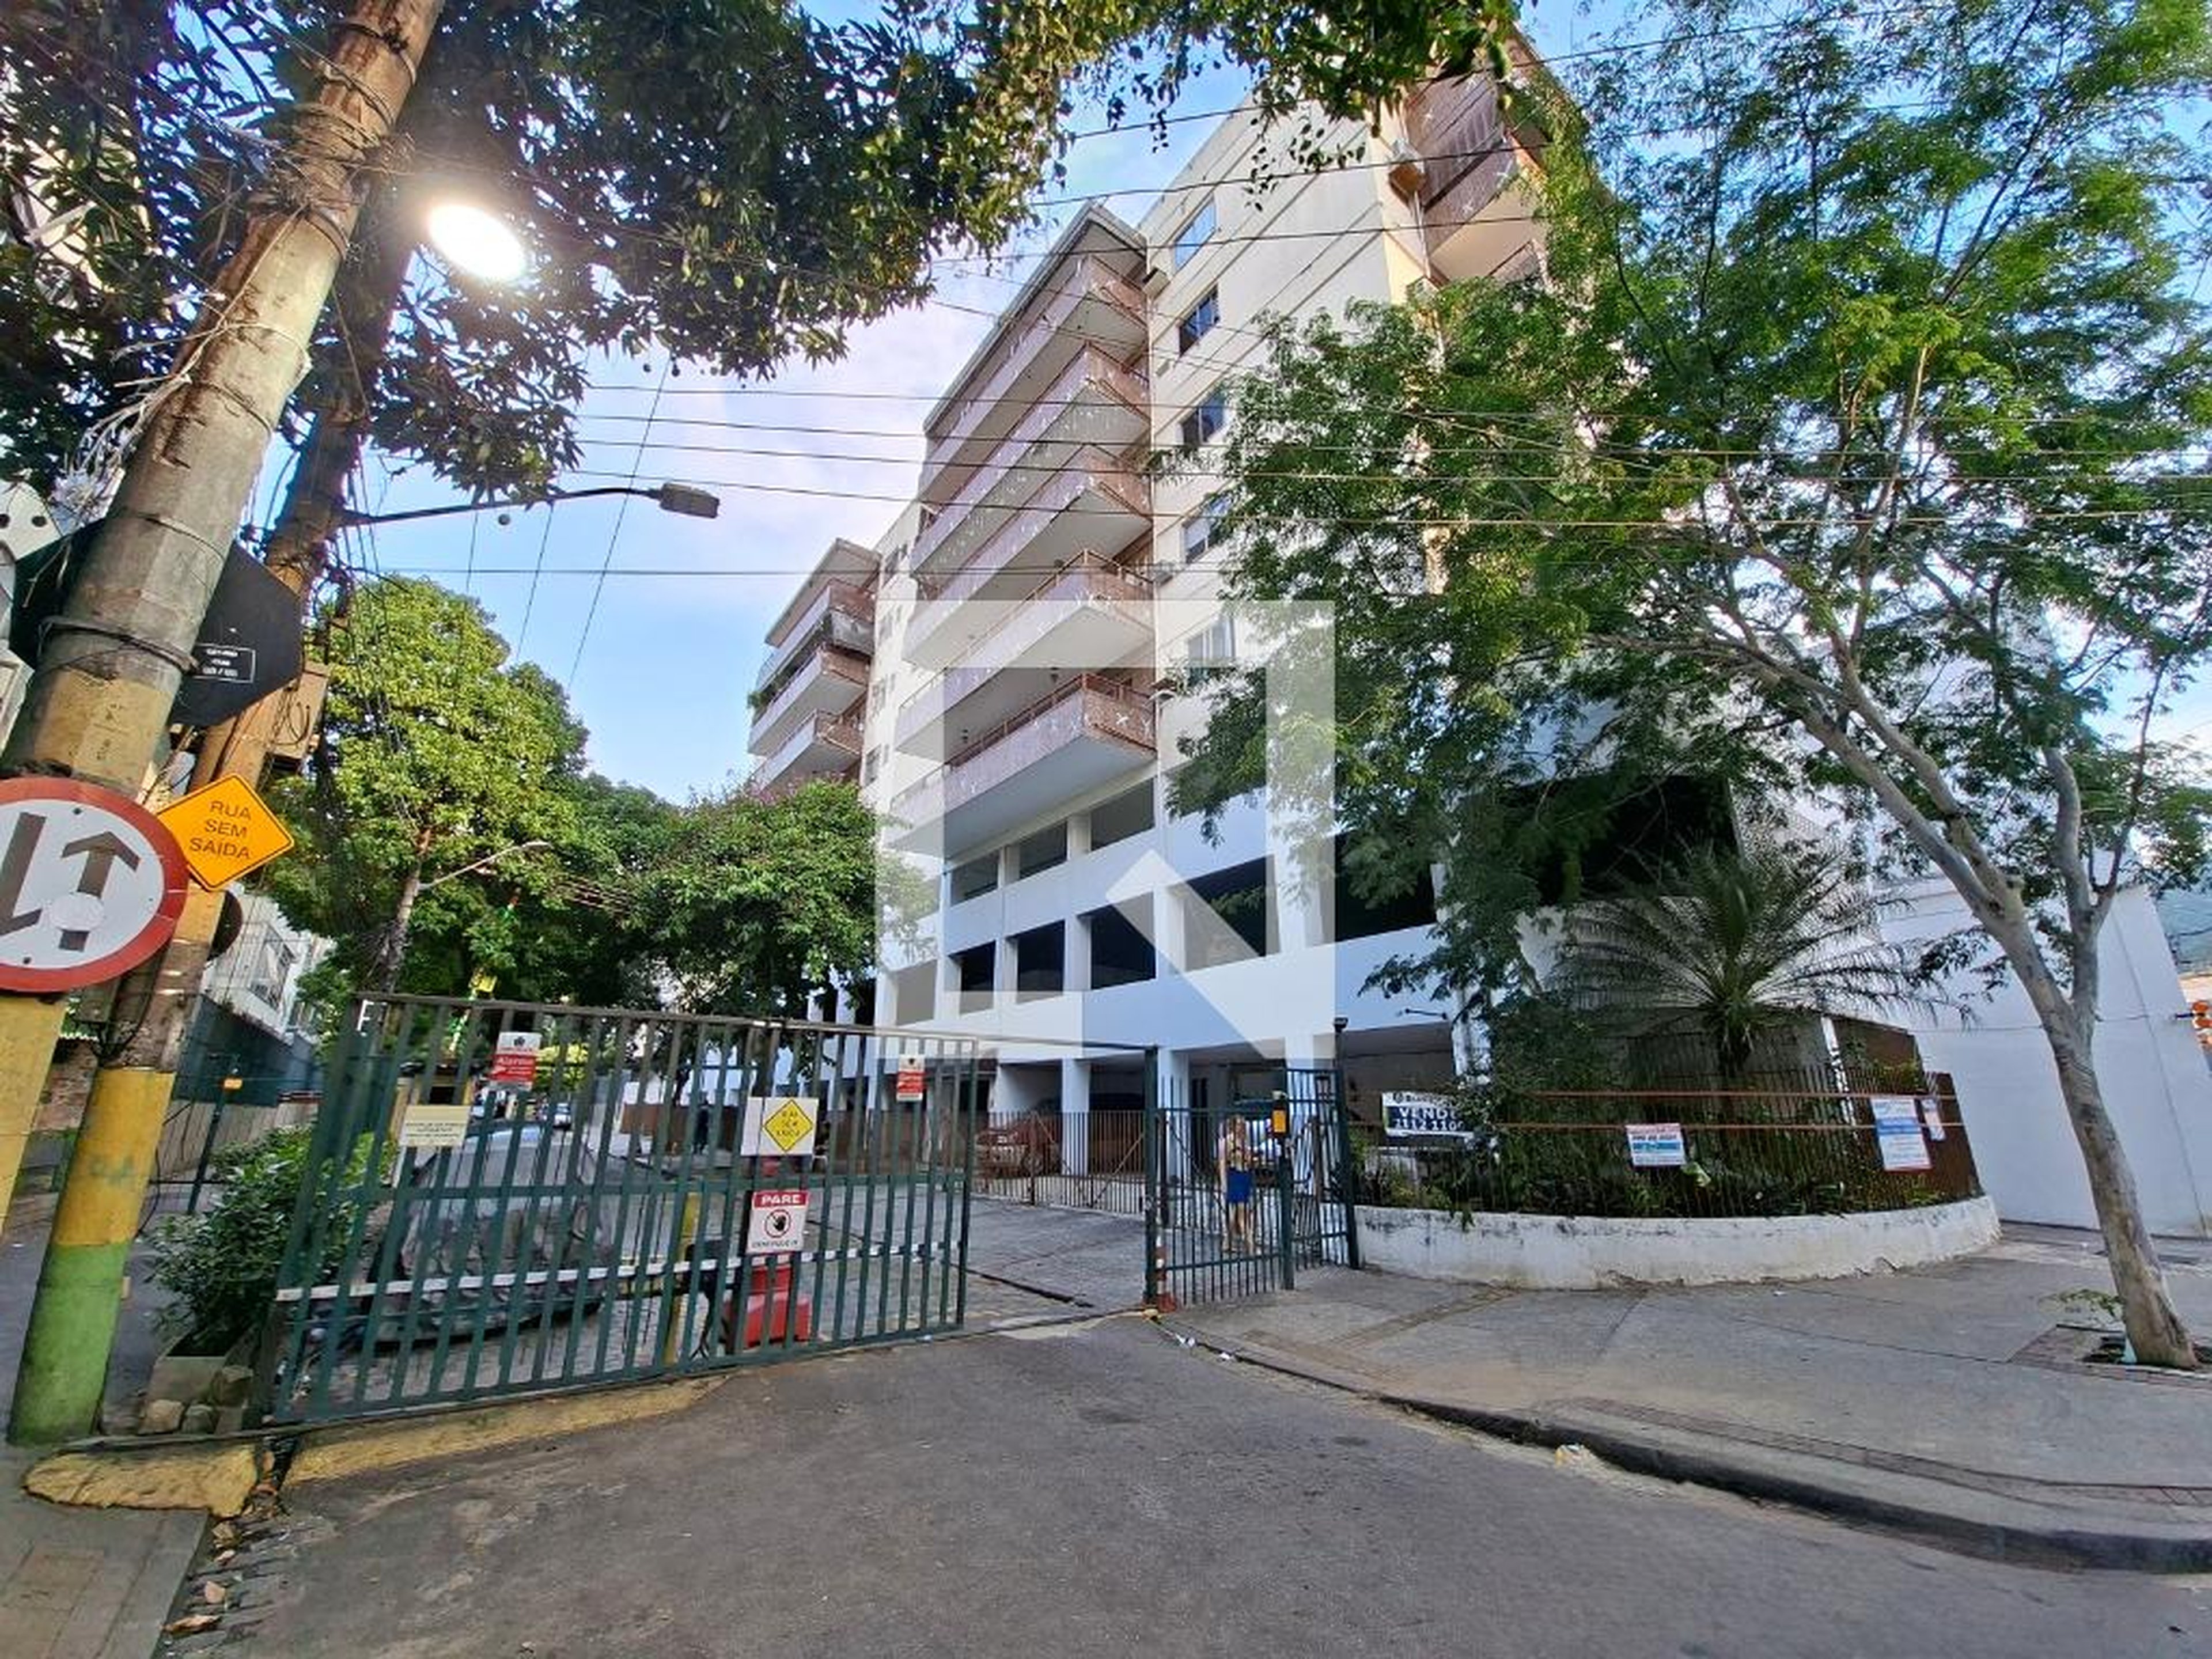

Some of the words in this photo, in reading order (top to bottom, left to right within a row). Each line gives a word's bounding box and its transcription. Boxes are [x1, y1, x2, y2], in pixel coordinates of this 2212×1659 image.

[210, 800, 251, 820] RUA
[204, 819, 247, 838] SEM
[762, 1194, 800, 1205] PARE
